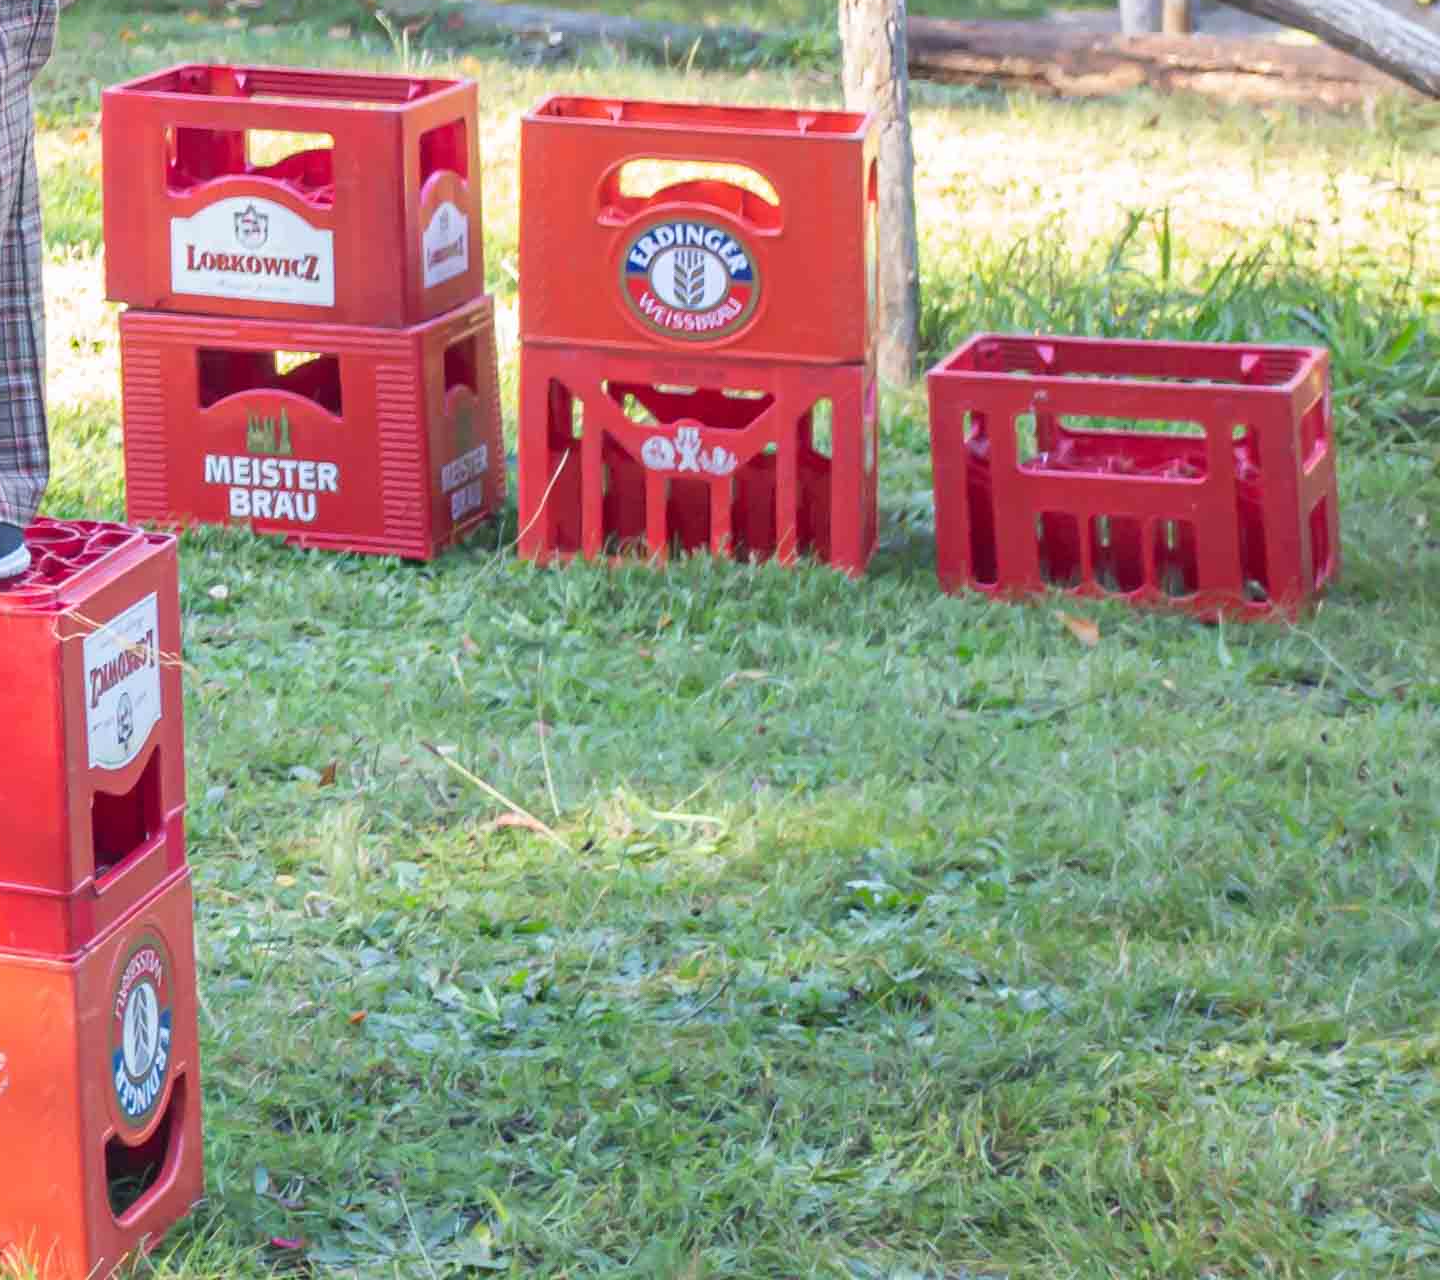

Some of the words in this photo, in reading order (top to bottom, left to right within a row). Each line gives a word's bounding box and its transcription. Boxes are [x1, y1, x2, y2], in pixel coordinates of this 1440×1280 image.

[185, 243, 320, 282] LOBKOWICZ
[630, 223, 748, 275] ERDINGER
[204, 454, 339, 492] MEISTER
[229, 489, 318, 522] BRÄU
[114, 1028, 171, 1116] ERDINGER
